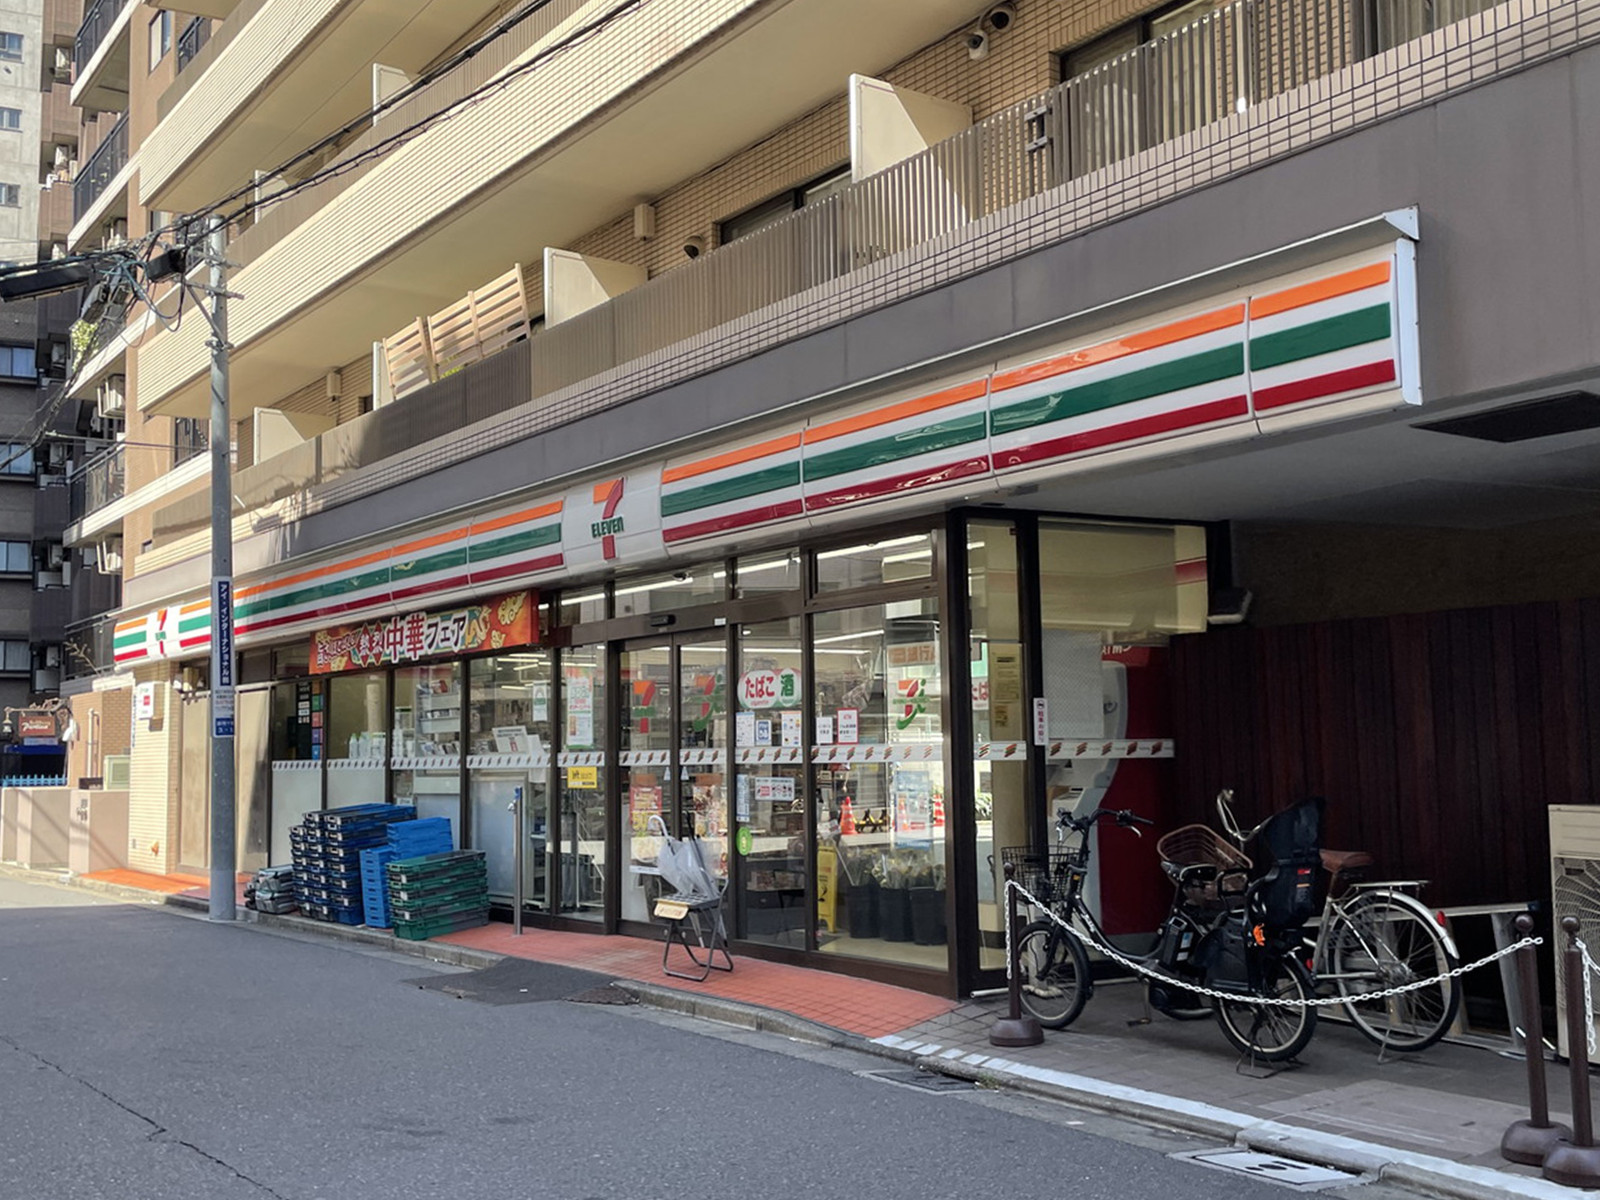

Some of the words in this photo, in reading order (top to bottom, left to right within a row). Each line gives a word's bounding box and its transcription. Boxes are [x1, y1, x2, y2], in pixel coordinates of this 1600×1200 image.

[593, 477, 624, 560] 7
[745, 675, 775, 699] たばこ
[780, 674, 794, 697] 酒
